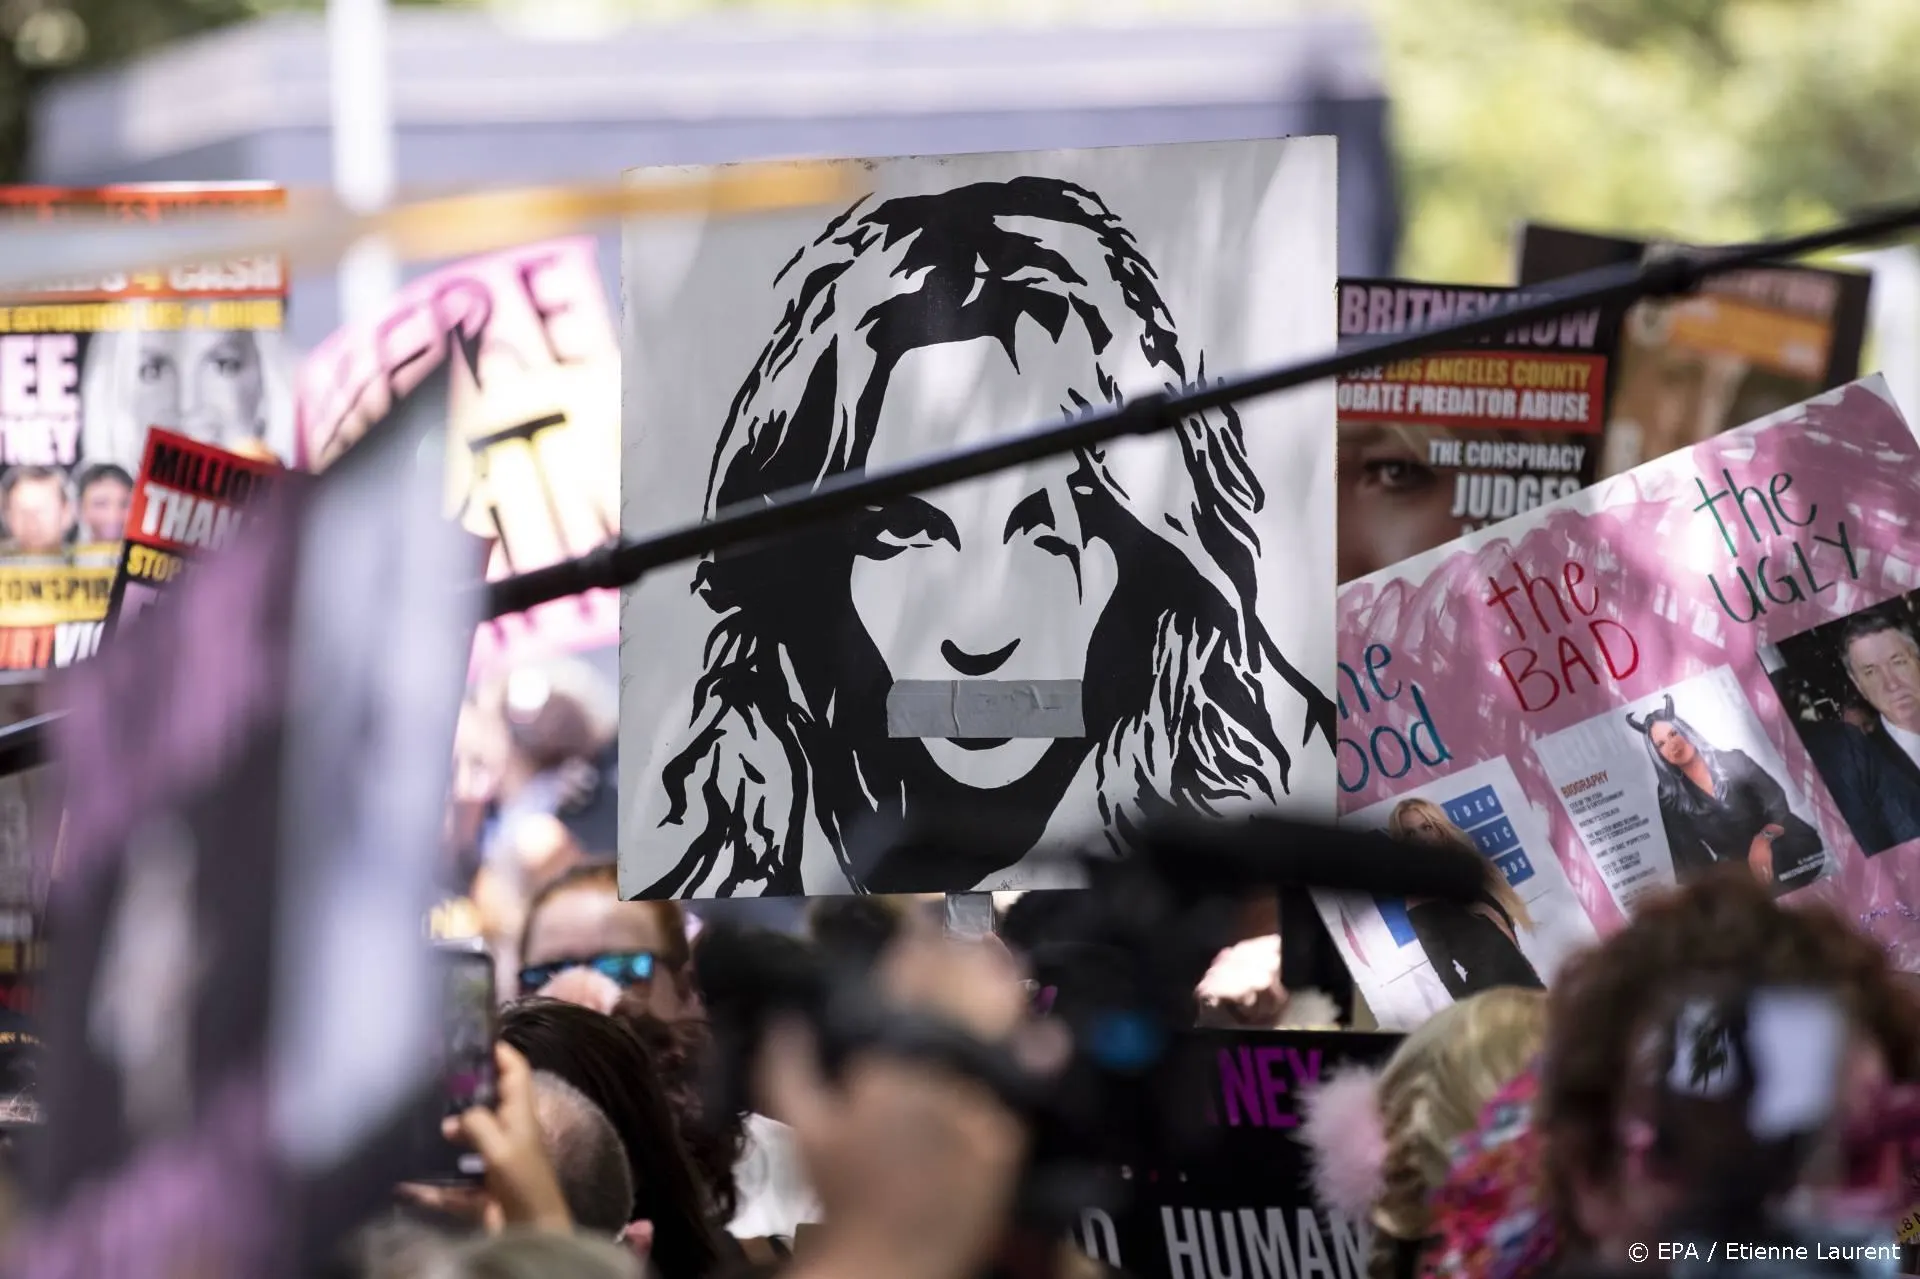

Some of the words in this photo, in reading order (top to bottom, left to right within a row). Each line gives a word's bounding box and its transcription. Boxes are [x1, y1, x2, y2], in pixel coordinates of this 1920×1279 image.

[1338, 382, 1404, 413] OBATE
[1406, 384, 1518, 418] PREDATOR
[1520, 392, 1590, 422] ABUSE
[1385, 357, 1423, 381] LOS
[1425, 357, 1508, 386] ANGELES
[1512, 361, 1592, 389] COUNTY
[0, 417, 80, 467] NEY
[1429, 438, 1463, 466] THE
[1466, 440, 1586, 472] CONSPIRACY
[1692, 467, 1818, 558] the
[1486, 560, 1600, 642] the
[1707, 521, 1859, 624] UGLY
[1337, 643, 1403, 721] he
[1498, 618, 1640, 713] BAD
[1337, 684, 1454, 794] ood
[1452, 795, 1497, 822] IDEO
[1481, 825, 1512, 849] SIC
[1216, 1045, 1323, 1128] NEY
